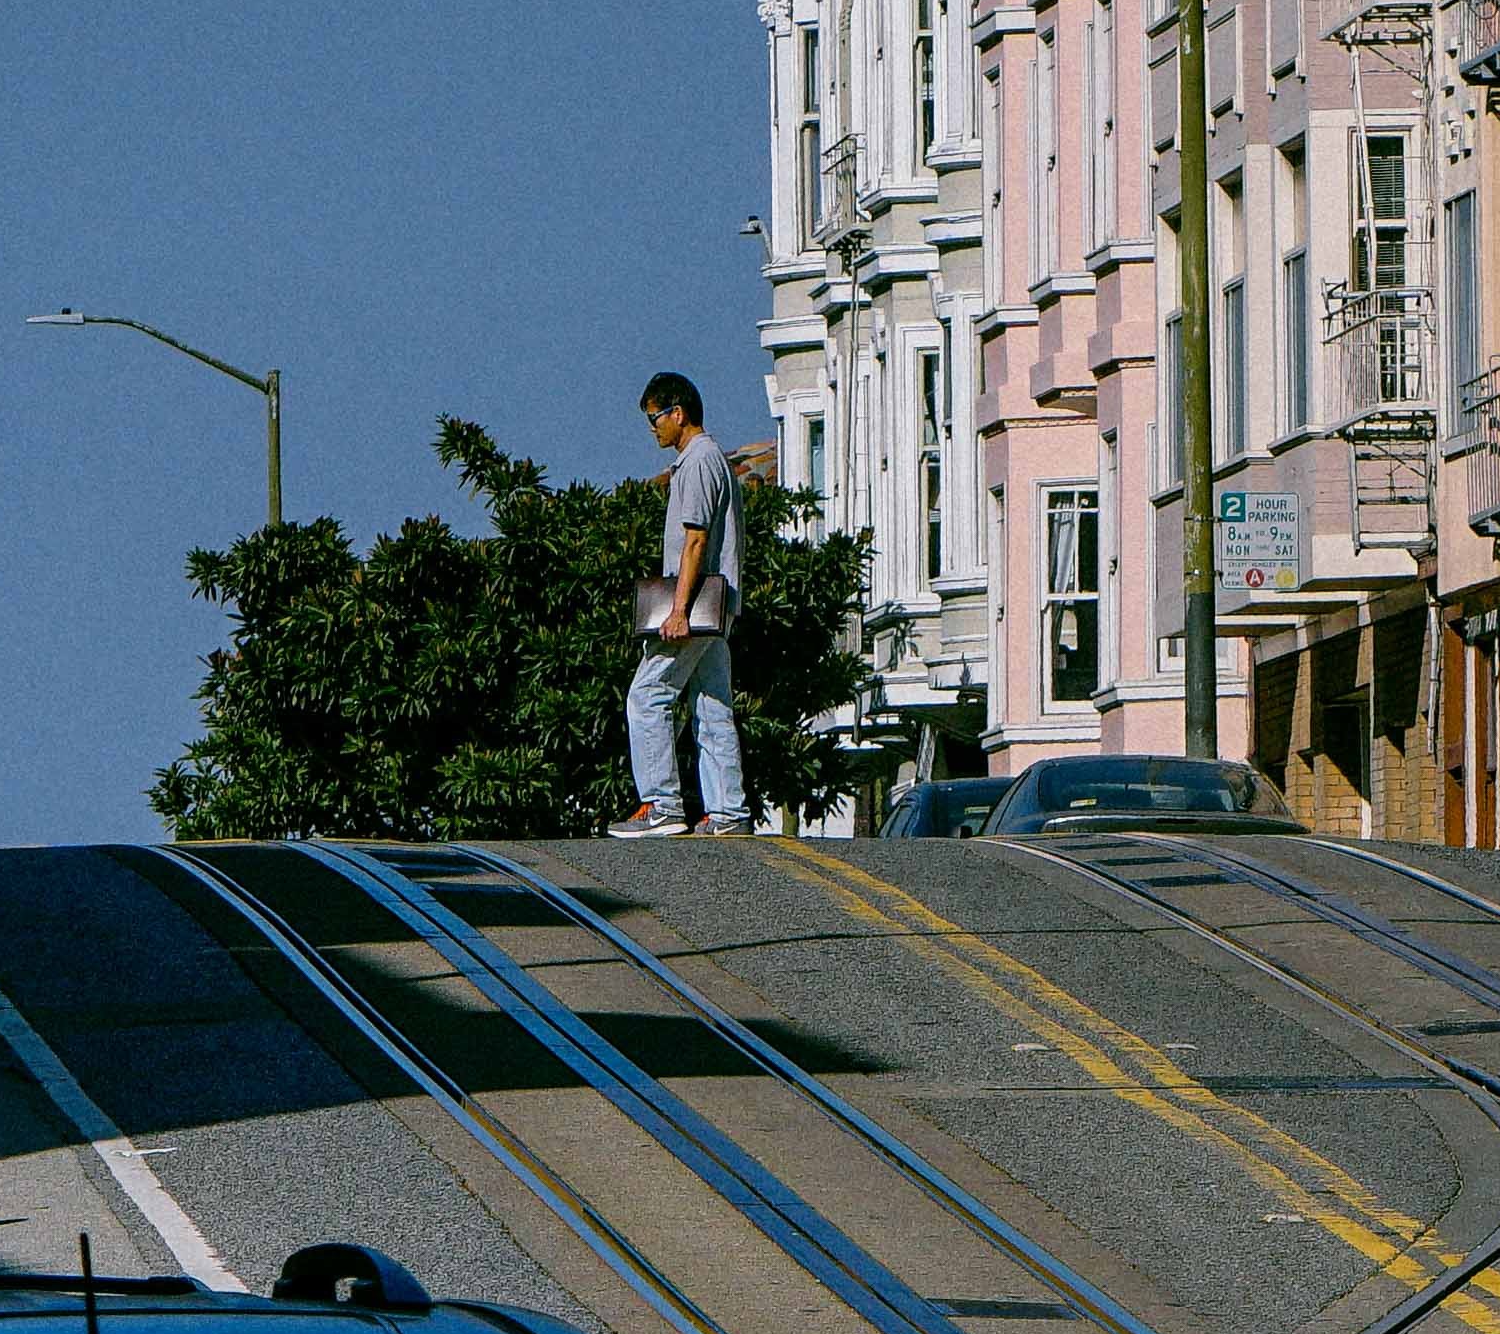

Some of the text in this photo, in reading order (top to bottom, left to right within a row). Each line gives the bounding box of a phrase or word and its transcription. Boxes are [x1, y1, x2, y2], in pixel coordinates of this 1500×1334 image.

[1226, 497, 1242, 517] 2
[1256, 498, 1288, 510] HOUR
[1248, 511, 1296, 523] PARKING
[1228, 526, 1237, 541] 8
[1269, 526, 1279, 541] 9
[1226, 544, 1250, 556] MON
[1275, 545, 1294, 556] SAT
[1249, 570, 1261, 585] A
